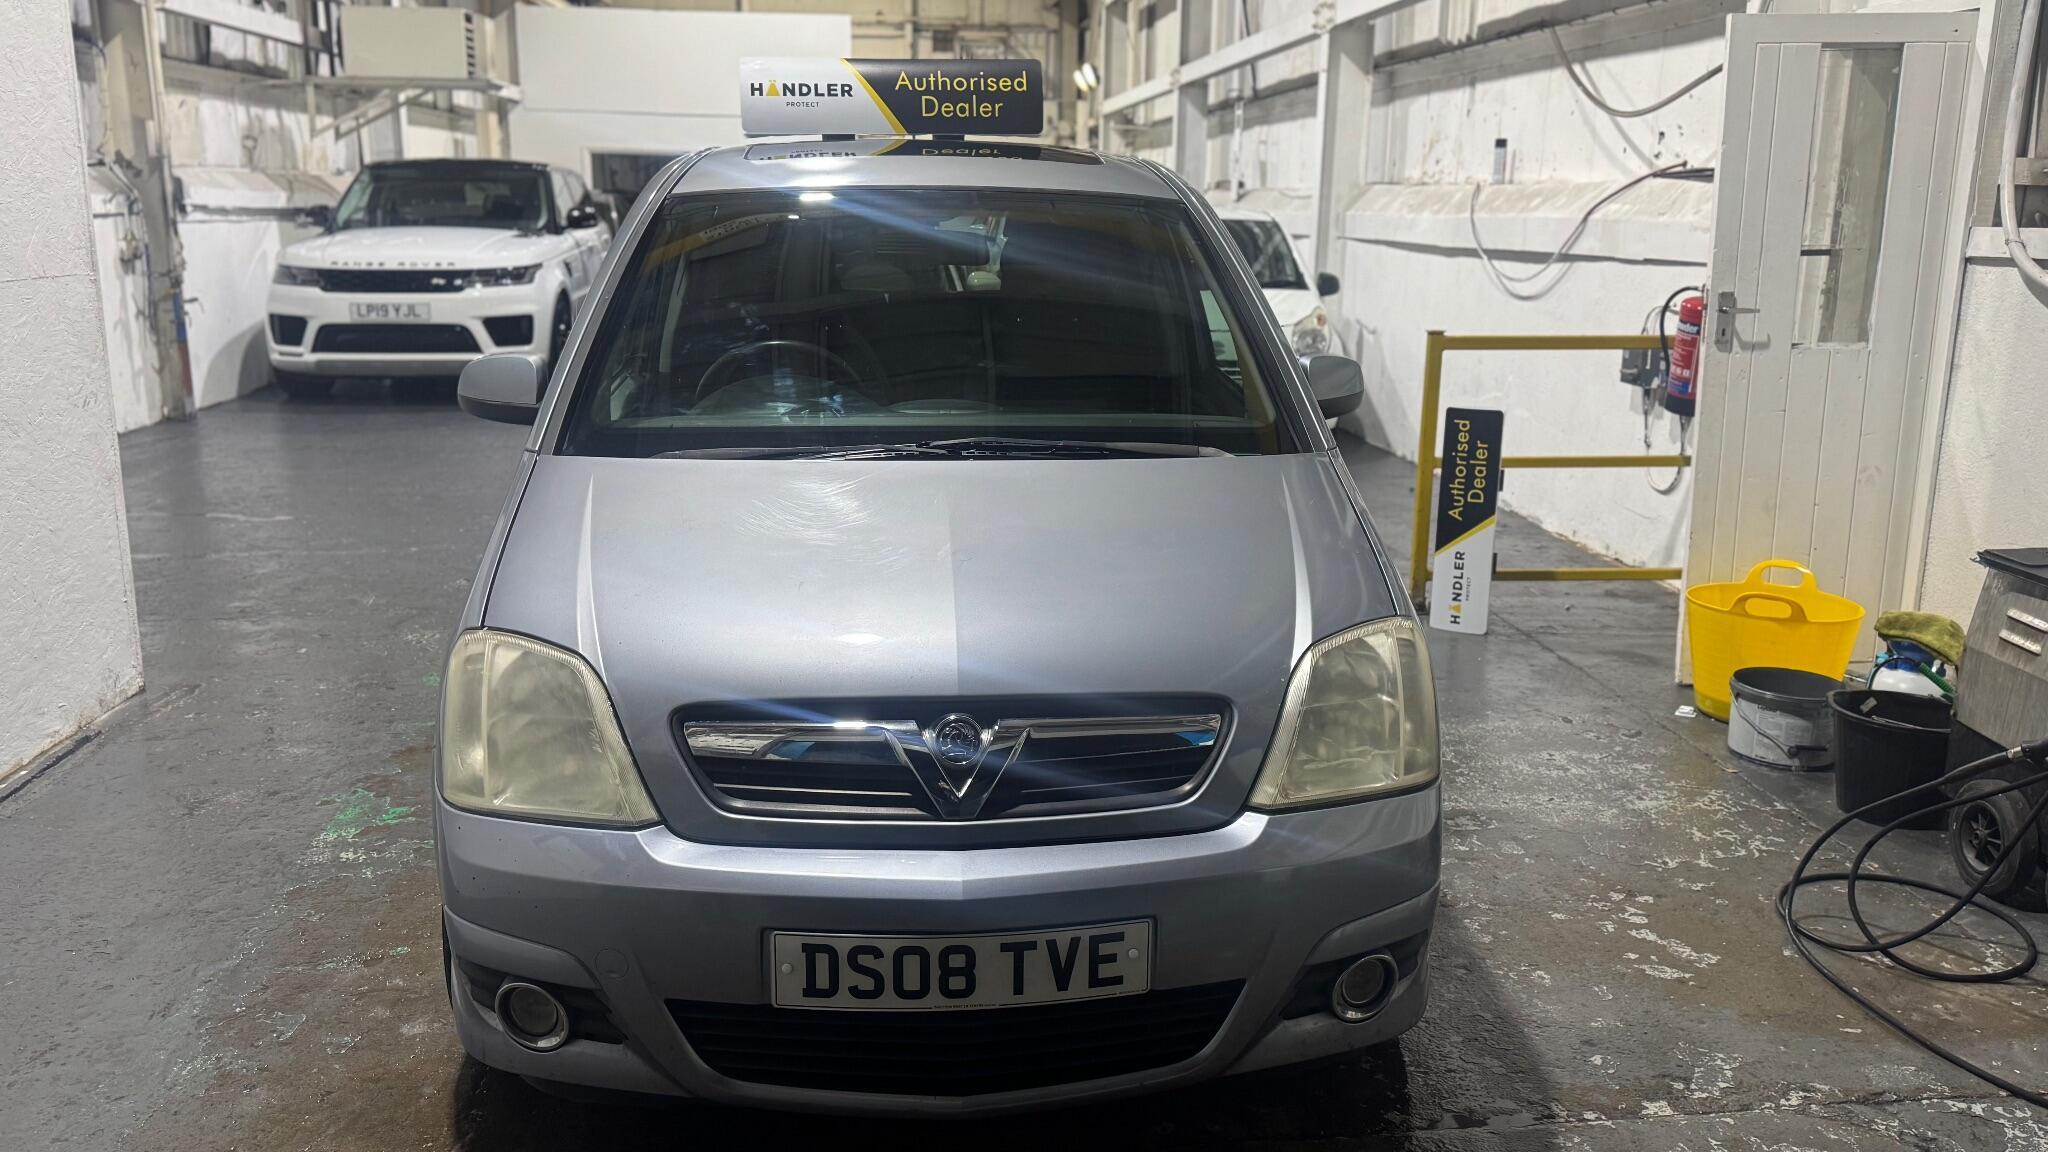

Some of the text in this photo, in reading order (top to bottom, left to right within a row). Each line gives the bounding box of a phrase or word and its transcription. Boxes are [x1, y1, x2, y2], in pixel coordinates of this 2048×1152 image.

[895, 70, 1027, 93] Authorised
[921, 95, 1003, 118] Dealer
[357, 304, 421, 318] LP19 YJL
[1448, 419, 1471, 521] Authorised
[1467, 440, 1489, 504] Dealer
[802, 931, 1125, 1000] DS08 TVE
